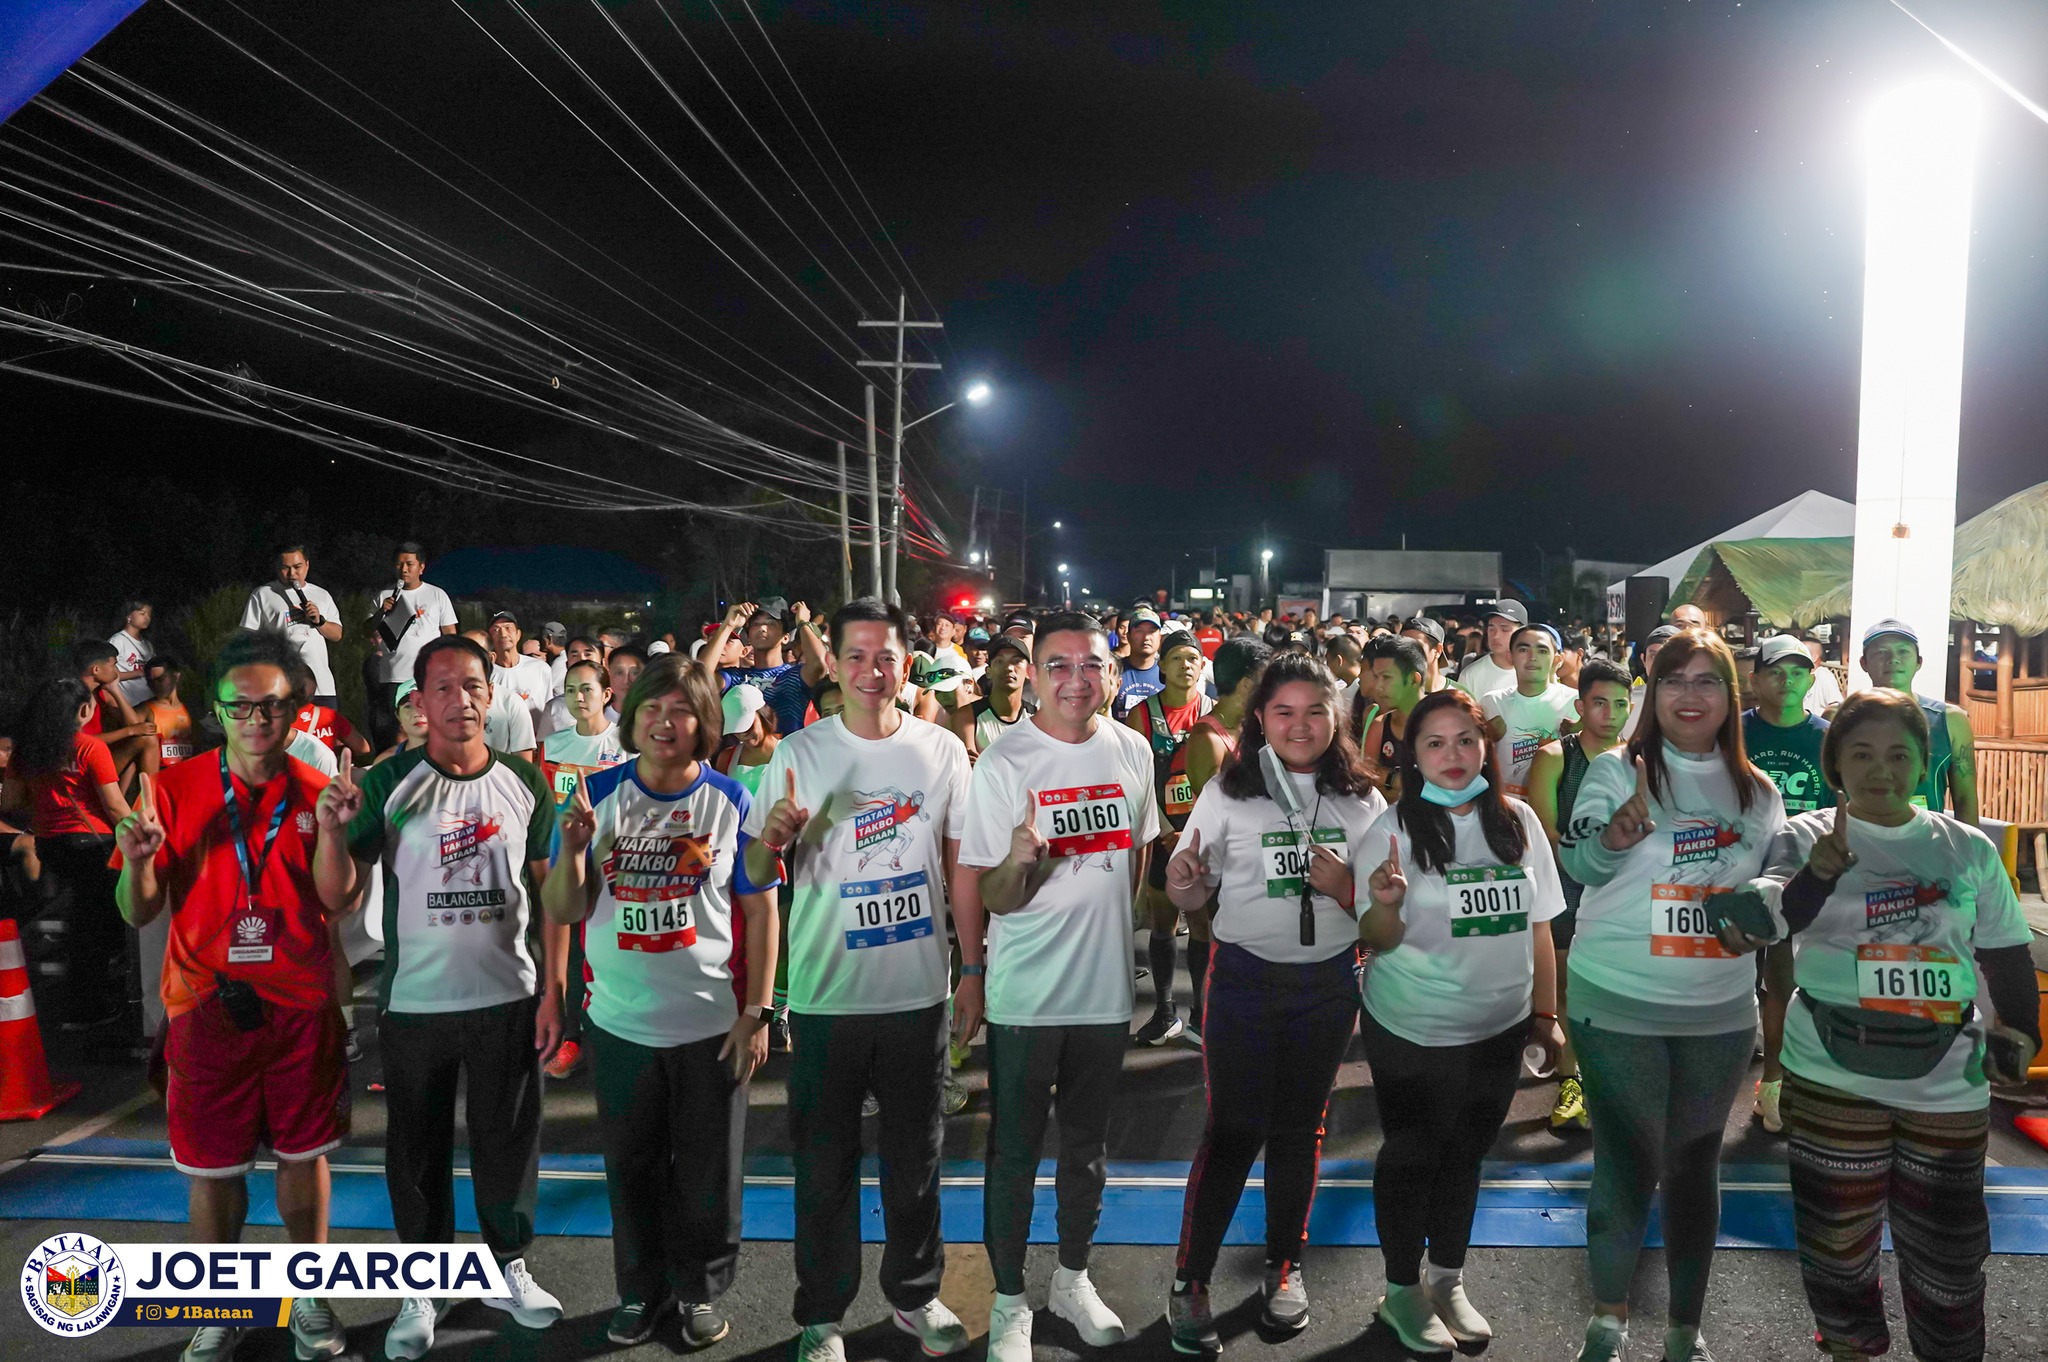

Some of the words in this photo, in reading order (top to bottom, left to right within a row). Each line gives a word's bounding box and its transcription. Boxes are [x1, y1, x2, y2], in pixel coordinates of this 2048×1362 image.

[1514, 738, 1539, 749] HATAW
[1514, 745, 1539, 755] TAKBO
[1514, 752, 1536, 763] BATAA
[1780, 750, 1801, 760] RUN
[1801, 758, 1821, 796] HARDER
[858, 805, 894, 827] HATAW
[1052, 803, 1119, 835] 50160
[442, 825, 476, 843] HATAW
[858, 817, 894, 838] TAKBO
[1676, 828, 1715, 842] HATAW
[443, 835, 476, 854] TAKBO
[615, 836, 672, 852] HATAW
[858, 827, 895, 848] BATAAN
[1677, 838, 1716, 853] TAKBO
[442, 845, 476, 863] BATAAN
[619, 853, 677, 872] TAKBO
[1674, 849, 1716, 863] BATAAN
[428, 892, 485, 907] BALANGA
[1460, 885, 1520, 915] 30011
[1868, 887, 1915, 902] HATAW
[855, 892, 921, 927] 10120
[1869, 898, 1916, 915] TAKBO
[623, 903, 688, 932] 50145
[1665, 906, 1715, 934] 160
[1869, 908, 1917, 926] BATAAN
[1874, 967, 1952, 998] 16103
